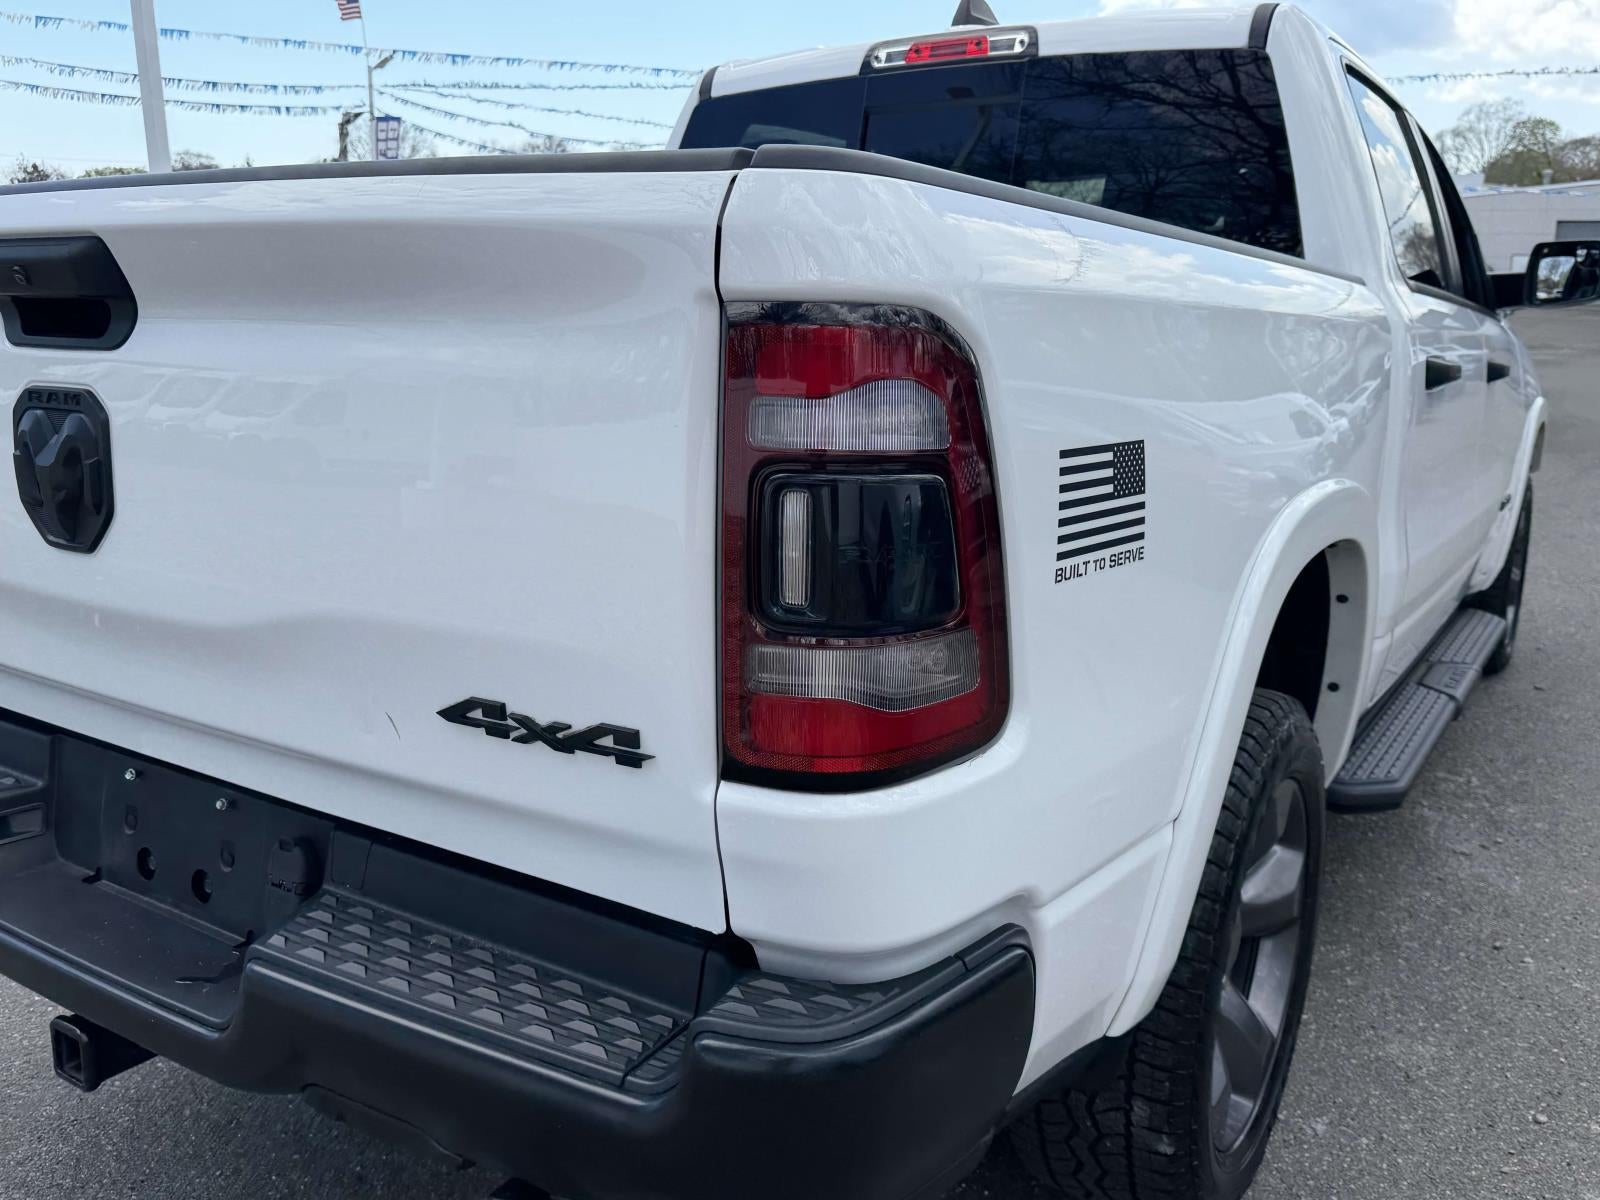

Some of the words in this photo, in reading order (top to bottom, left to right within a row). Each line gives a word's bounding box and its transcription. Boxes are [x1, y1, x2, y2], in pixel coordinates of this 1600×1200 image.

[27, 390, 81, 406] RAM
[1055, 560, 1091, 584] BUILT
[1093, 557, 1106, 572] TO
[1109, 546, 1145, 569] SERVE
